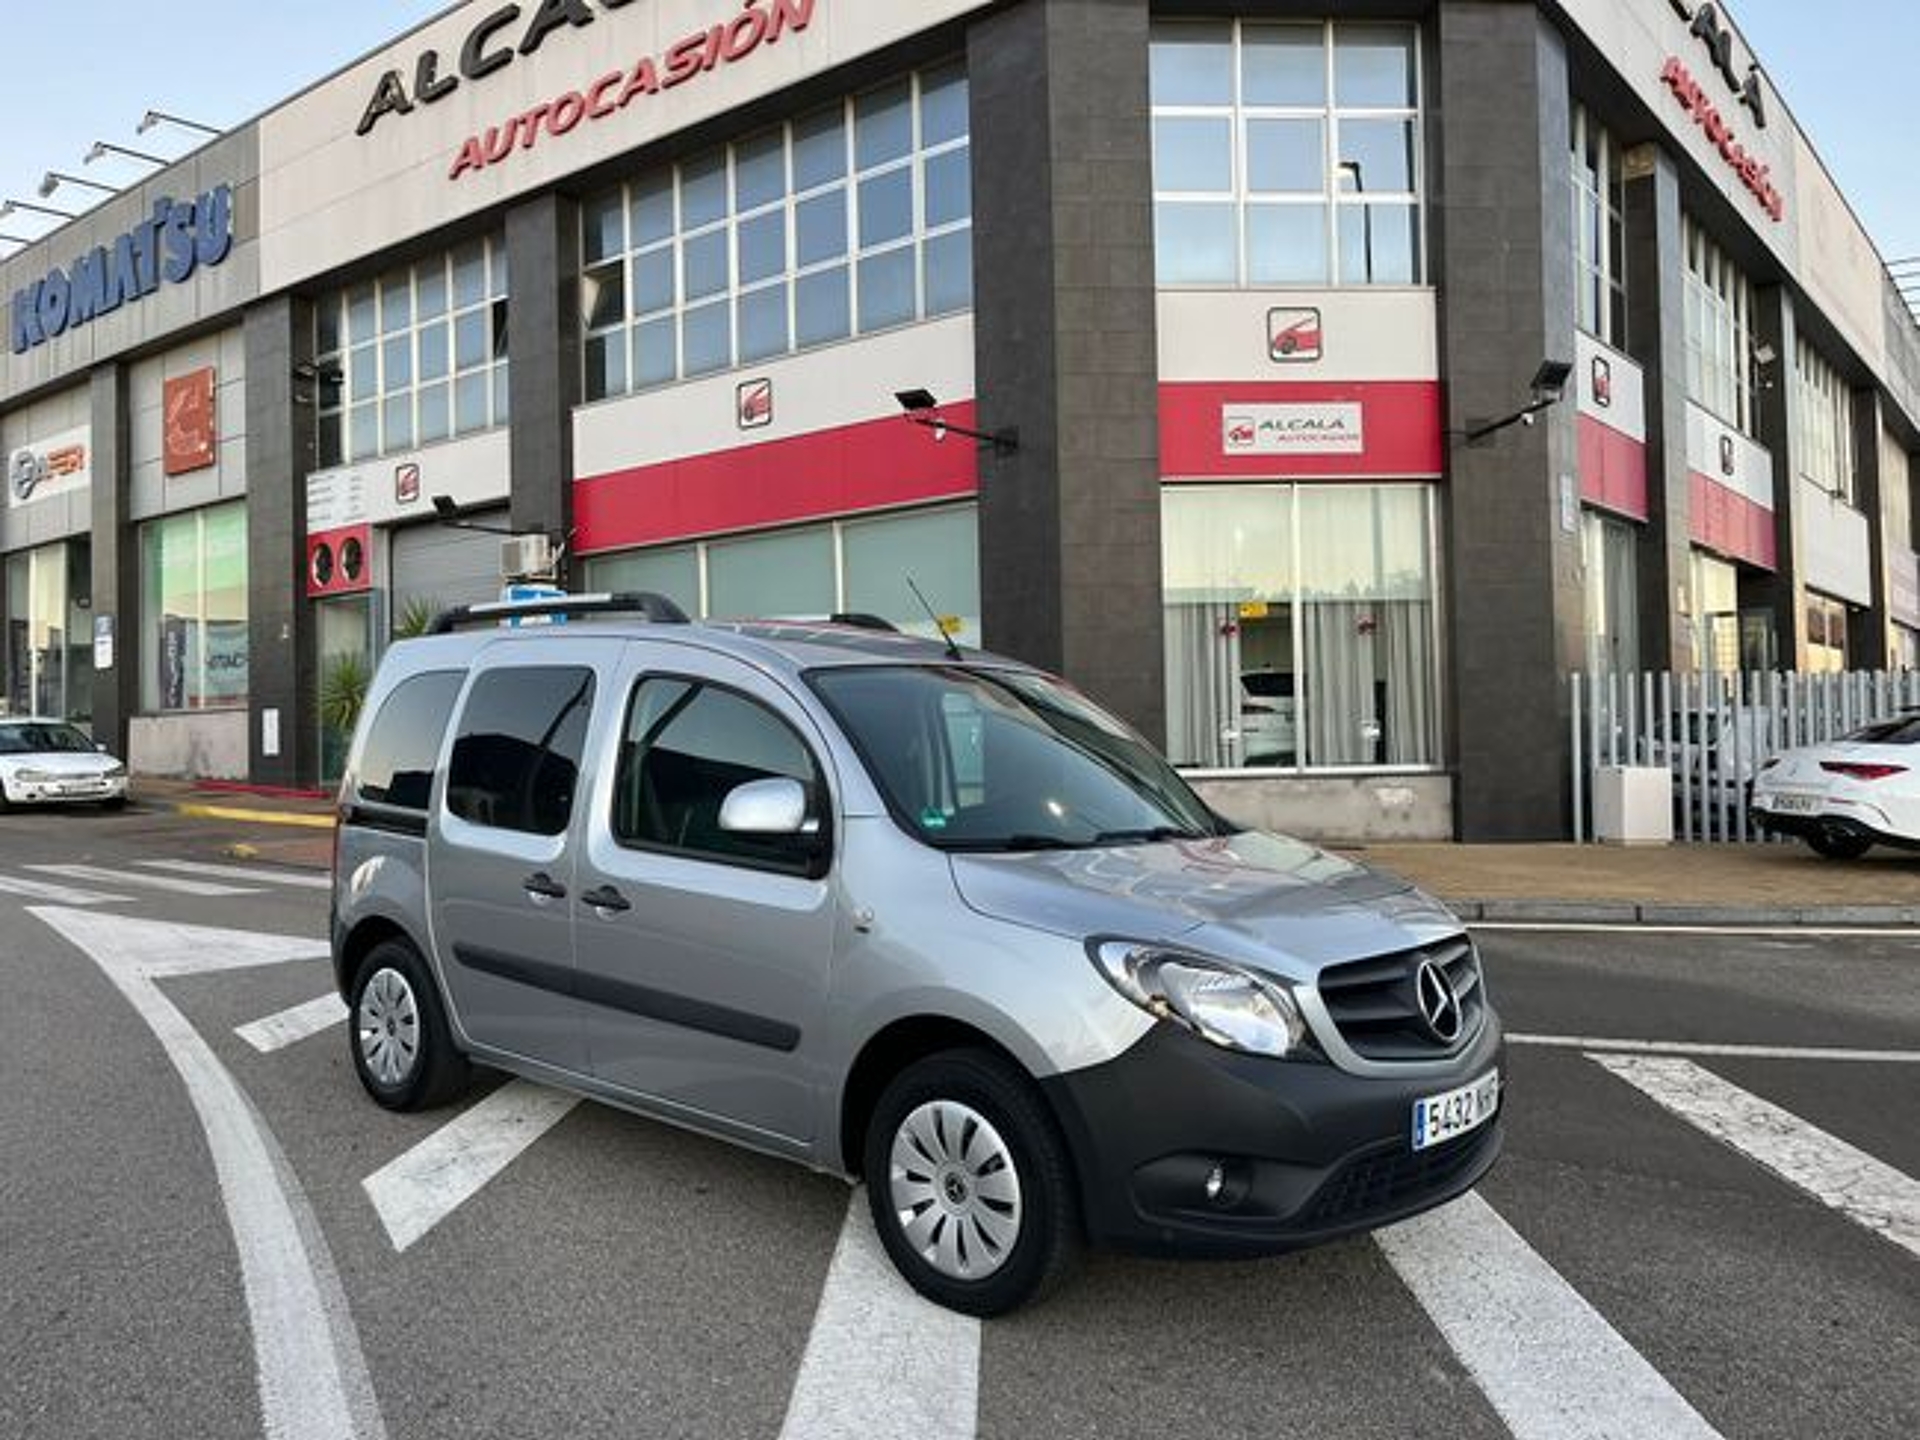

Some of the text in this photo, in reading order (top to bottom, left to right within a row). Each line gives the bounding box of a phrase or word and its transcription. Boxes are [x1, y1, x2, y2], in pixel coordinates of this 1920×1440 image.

[356, 0, 641, 136] ALCA
[448, 0, 816, 181] AUTOCASIÓN
[12, 182, 234, 354] KOMATSU
[1430, 1092, 1472, 1137] 5432
